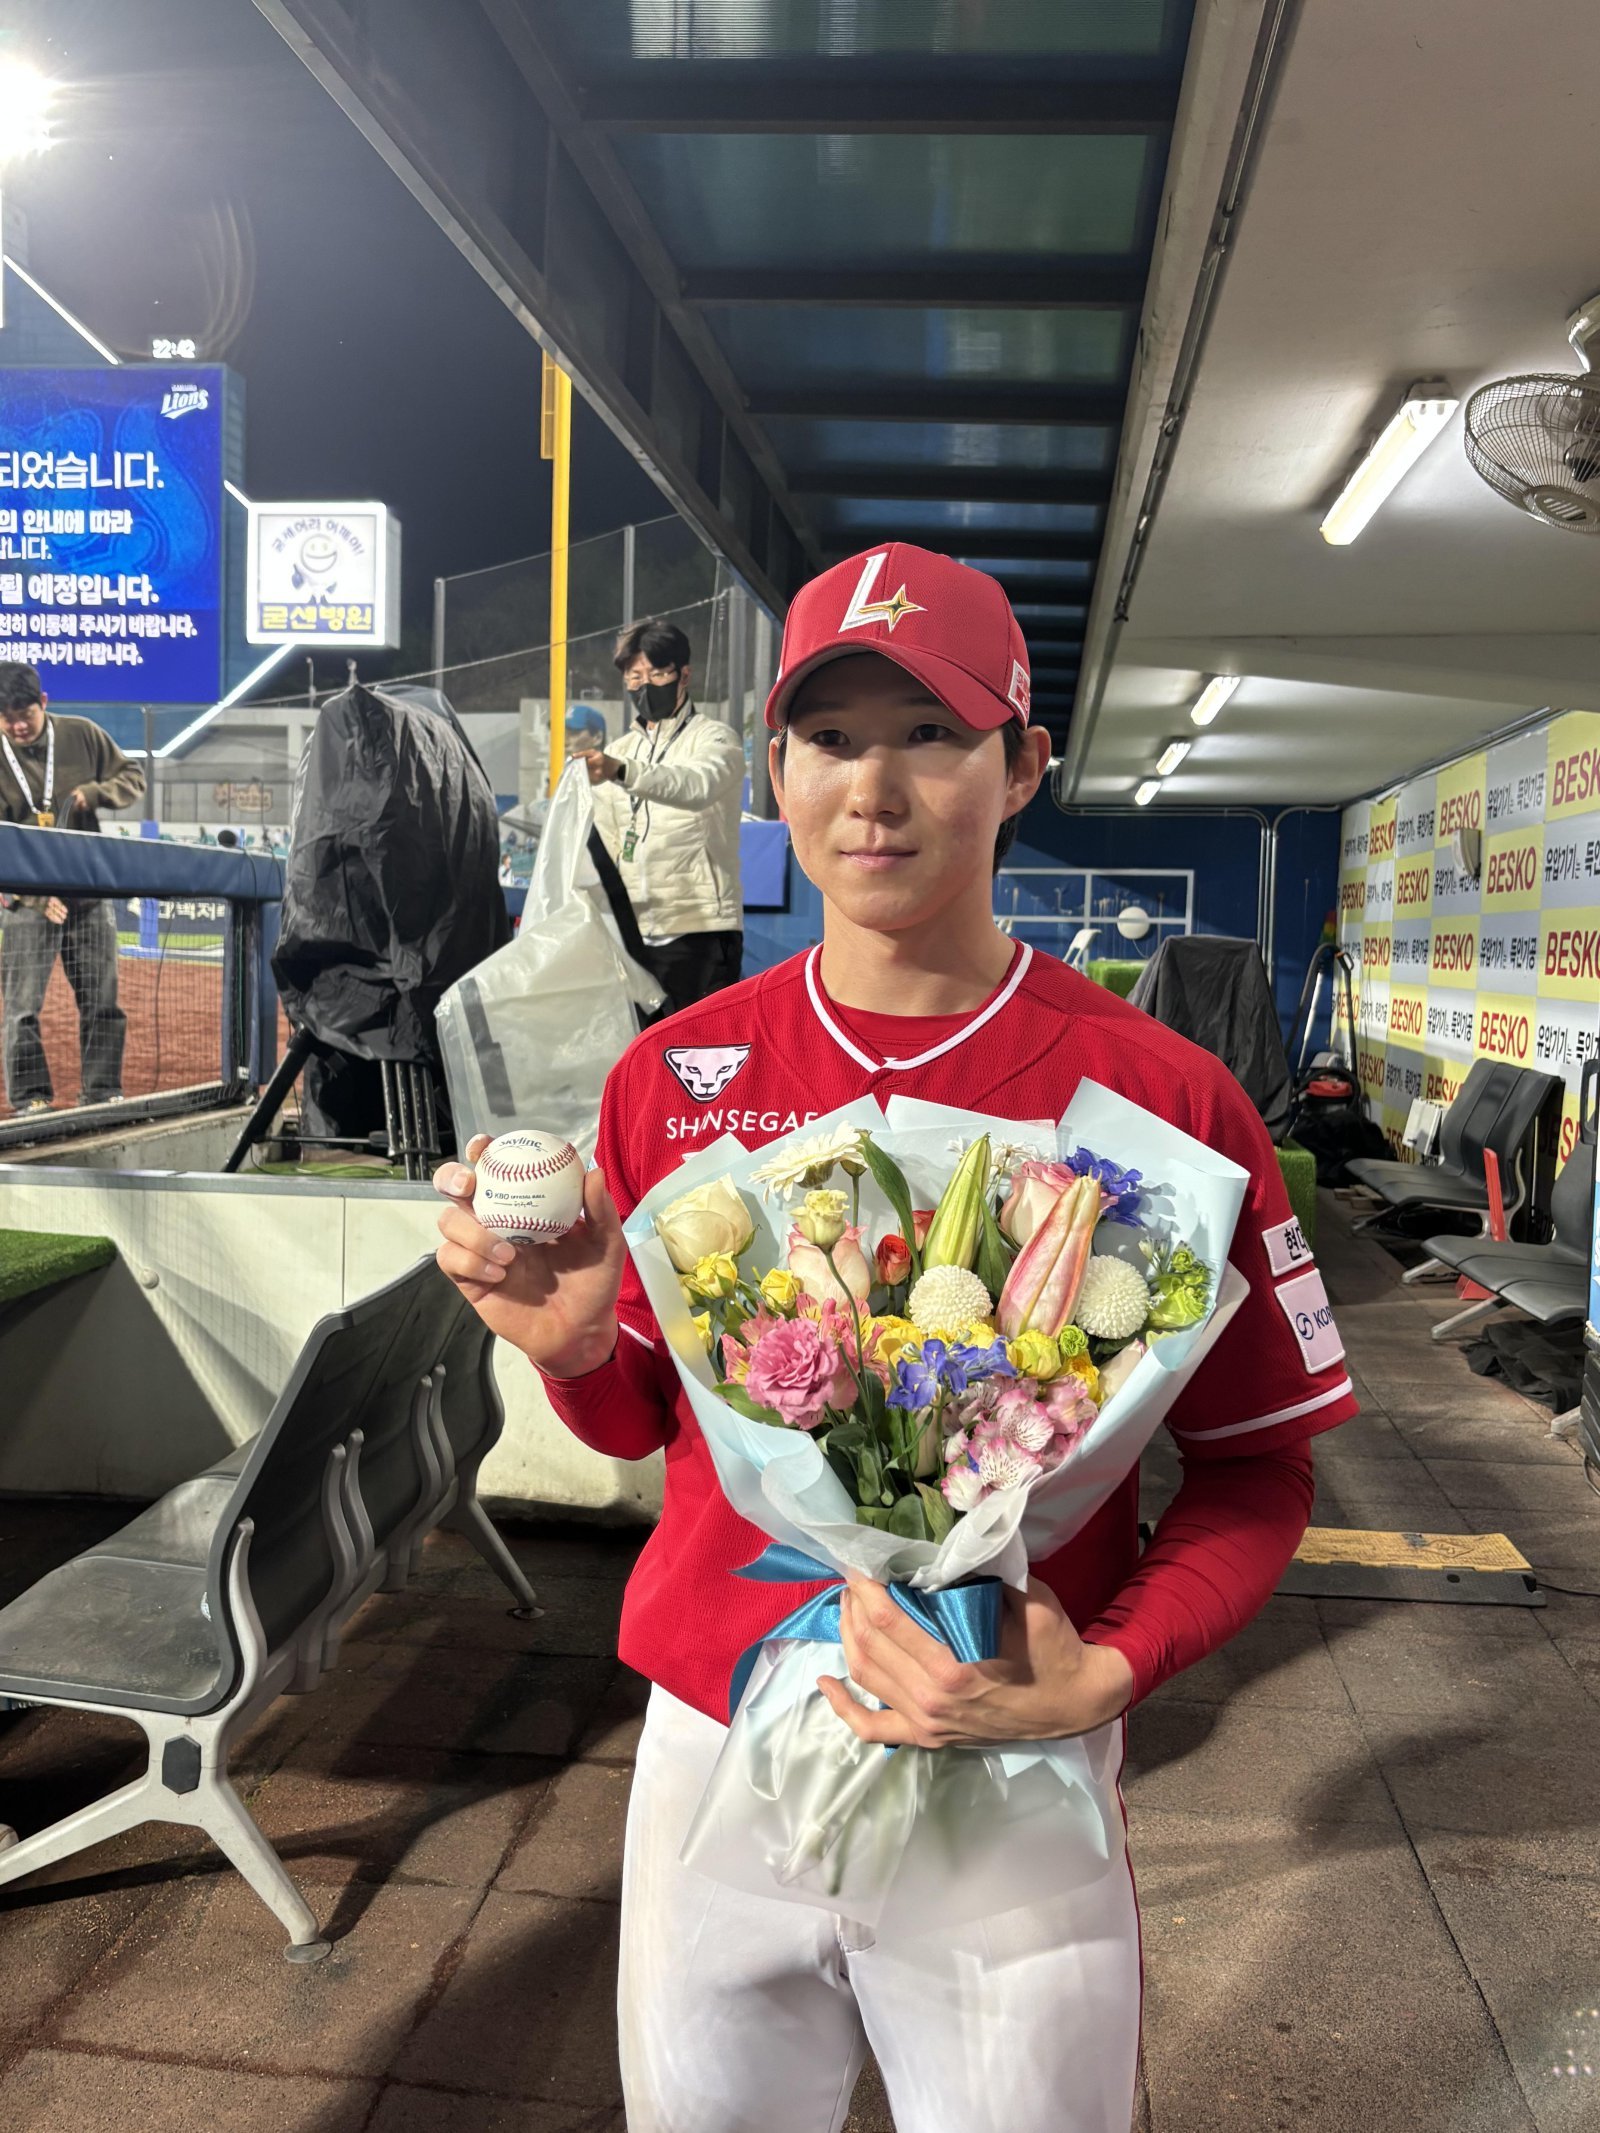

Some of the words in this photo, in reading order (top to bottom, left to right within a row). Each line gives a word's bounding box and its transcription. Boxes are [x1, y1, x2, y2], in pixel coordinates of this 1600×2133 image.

[160, 388, 209, 415] Lions
[0, 451, 165, 490] 되었습니다.
[22, 509, 85, 534] 안내에
[89, 509, 133, 534] 따라
[27, 573, 160, 606] 예정입니다.
[29, 613, 78, 637] 이동해
[79, 613, 127, 638] 주시기
[128, 613, 198, 638] 바랍니다.
[74, 641, 144, 666] 바랍니다.
[1439, 789, 1481, 837] BESKO
[1369, 820, 1396, 856] BESKO
[1487, 846, 1537, 894] BESKO
[1545, 843, 1581, 882] 유압기기는
[1341, 882, 1365, 910] BESKO
[1397, 868, 1429, 905] BESKO
[1433, 933, 1474, 972] BESKO
[1337, 992, 1360, 1021] BEO
[1390, 998, 1423, 1036] BESKO
[1479, 1011, 1529, 1059] BESKO
[1536, 1025, 1572, 1065] 유압기기는
[1360, 1052, 1385, 1088] BESKO
[1426, 1073, 1464, 1103] BESK
[494, 1192, 510, 1200] KBO
